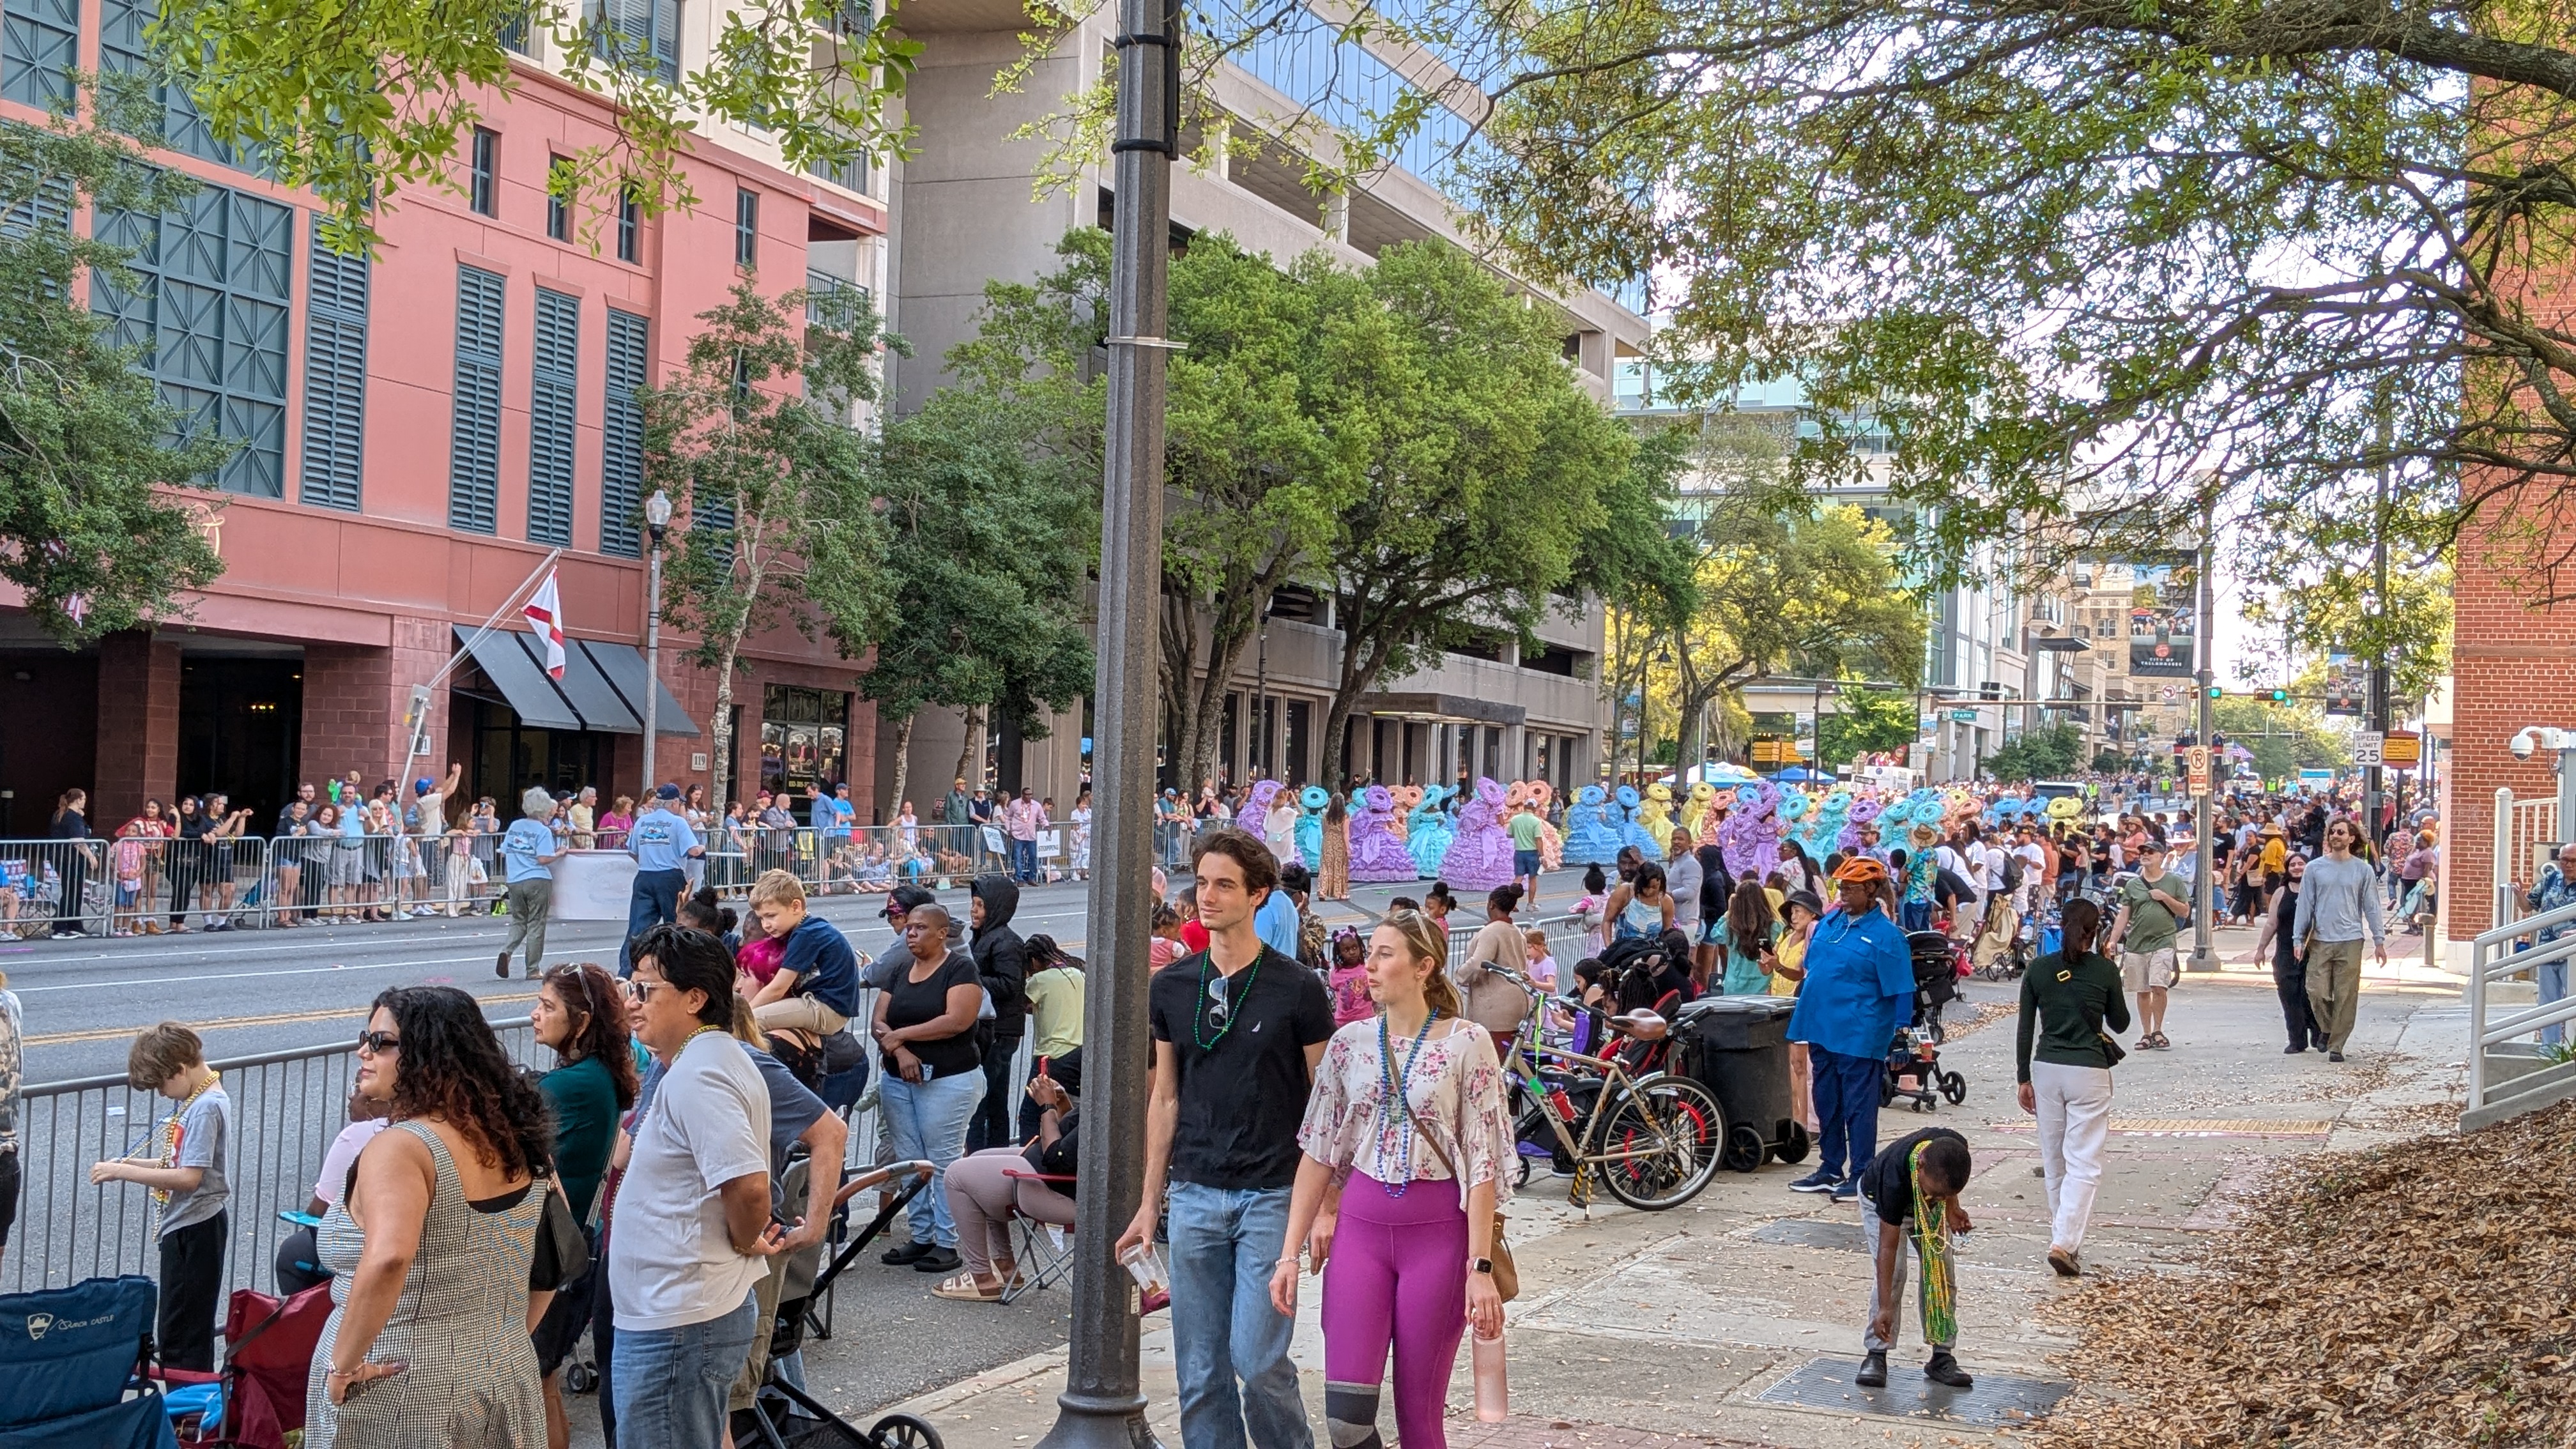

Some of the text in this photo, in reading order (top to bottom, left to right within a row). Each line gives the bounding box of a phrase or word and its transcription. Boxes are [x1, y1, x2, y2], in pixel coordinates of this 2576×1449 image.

[694, 755, 705, 765] 119
[2356, 749, 2379, 762] 25
[985, 831, 1001, 840] SPEED
[91, 1314, 114, 1326] CASTLE
